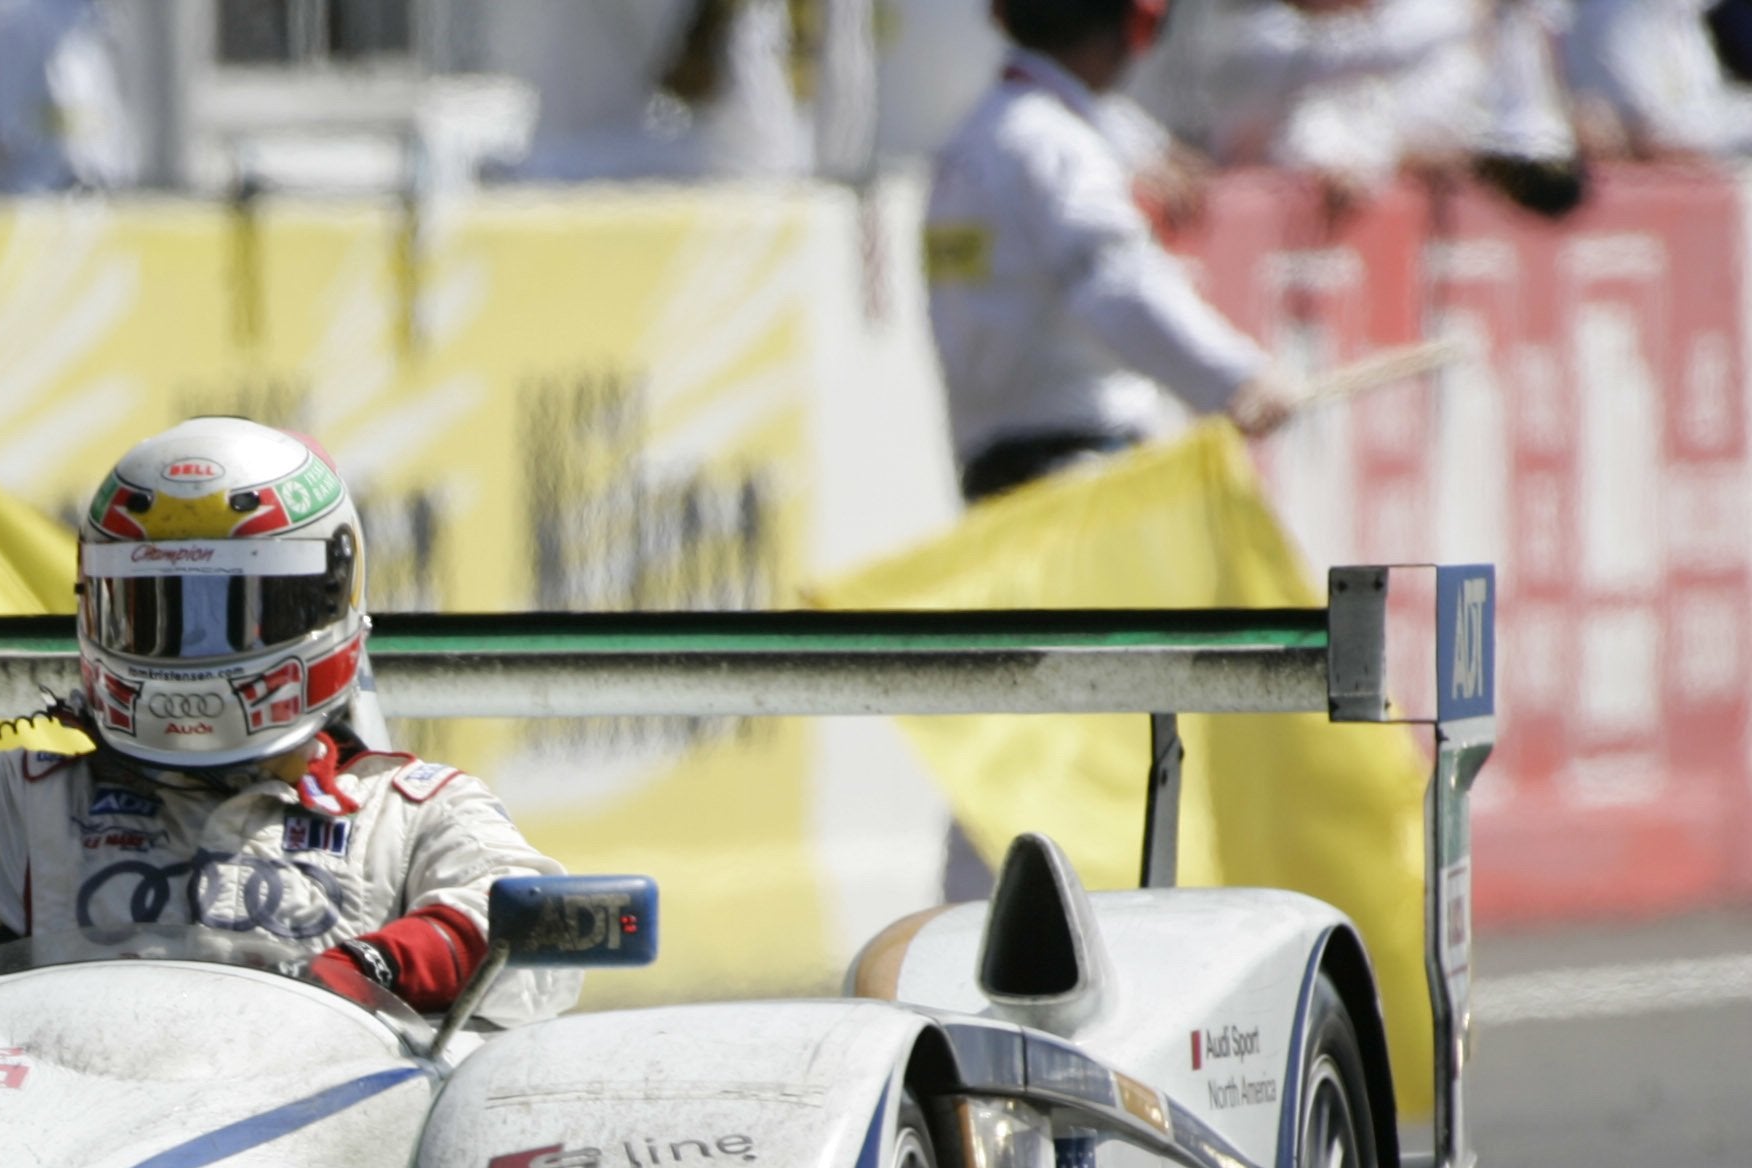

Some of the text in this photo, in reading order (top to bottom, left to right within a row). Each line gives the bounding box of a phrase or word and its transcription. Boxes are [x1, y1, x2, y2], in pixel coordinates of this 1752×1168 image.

[168, 463, 215, 477] BELL
[131, 543, 216, 565] Champion
[1452, 578, 1487, 700] ADT
[164, 722, 214, 735] Audi
[524, 893, 631, 951] ADT
[1206, 1025, 1260, 1063] Audi Sport
[1207, 1076, 1276, 1110] North America
